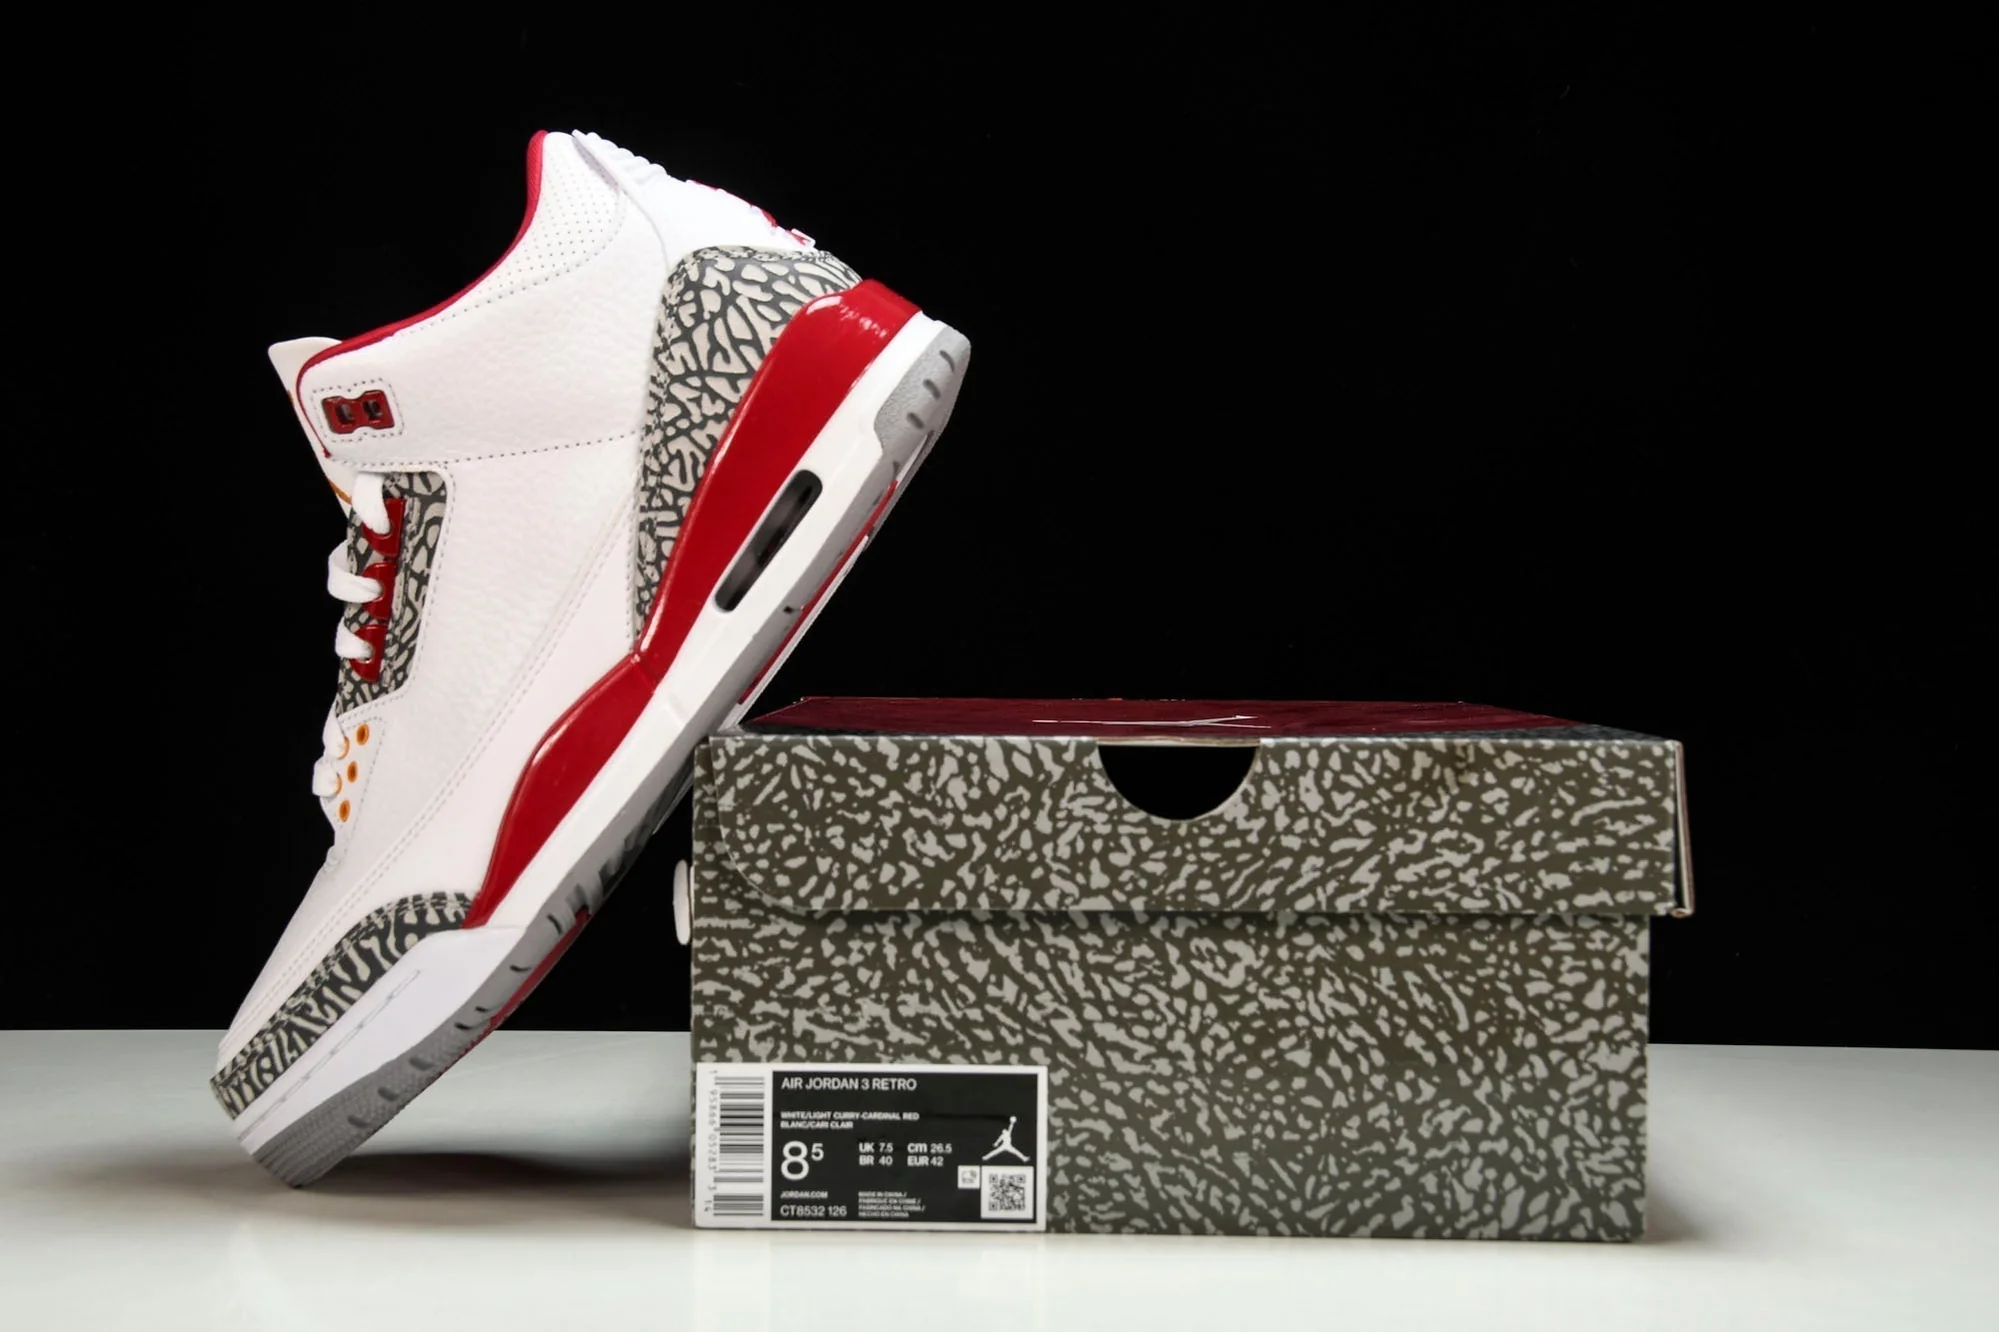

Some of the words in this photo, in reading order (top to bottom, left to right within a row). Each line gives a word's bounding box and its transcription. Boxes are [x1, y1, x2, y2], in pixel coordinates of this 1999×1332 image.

[781, 1077, 803, 1089] AIR
[805, 1077, 859, 1090] JORDAN
[861, 1079, 870, 1091] 3
[872, 1078, 917, 1091] RETRO
[781, 1111, 832, 1120] WHITE/LIGHT
[903, 1112, 920, 1121] RED
[830, 1121, 854, 1129] CLAIR
[859, 1142, 875, 1153] UK
[879, 1143, 894, 1153] 7.5
[907, 1143, 927, 1153] cm
[930, 1143, 952, 1154] 26.5
[859, 1155, 874, 1166] BR
[879, 1155, 893, 1166] 40
[907, 1155, 929, 1167] EUR
[930, 1156, 944, 1167] 42
[781, 1190, 828, 1199] JORDAN.COM
[780, 1205, 825, 1217] CT8532
[827, 1205, 847, 1217] 126
